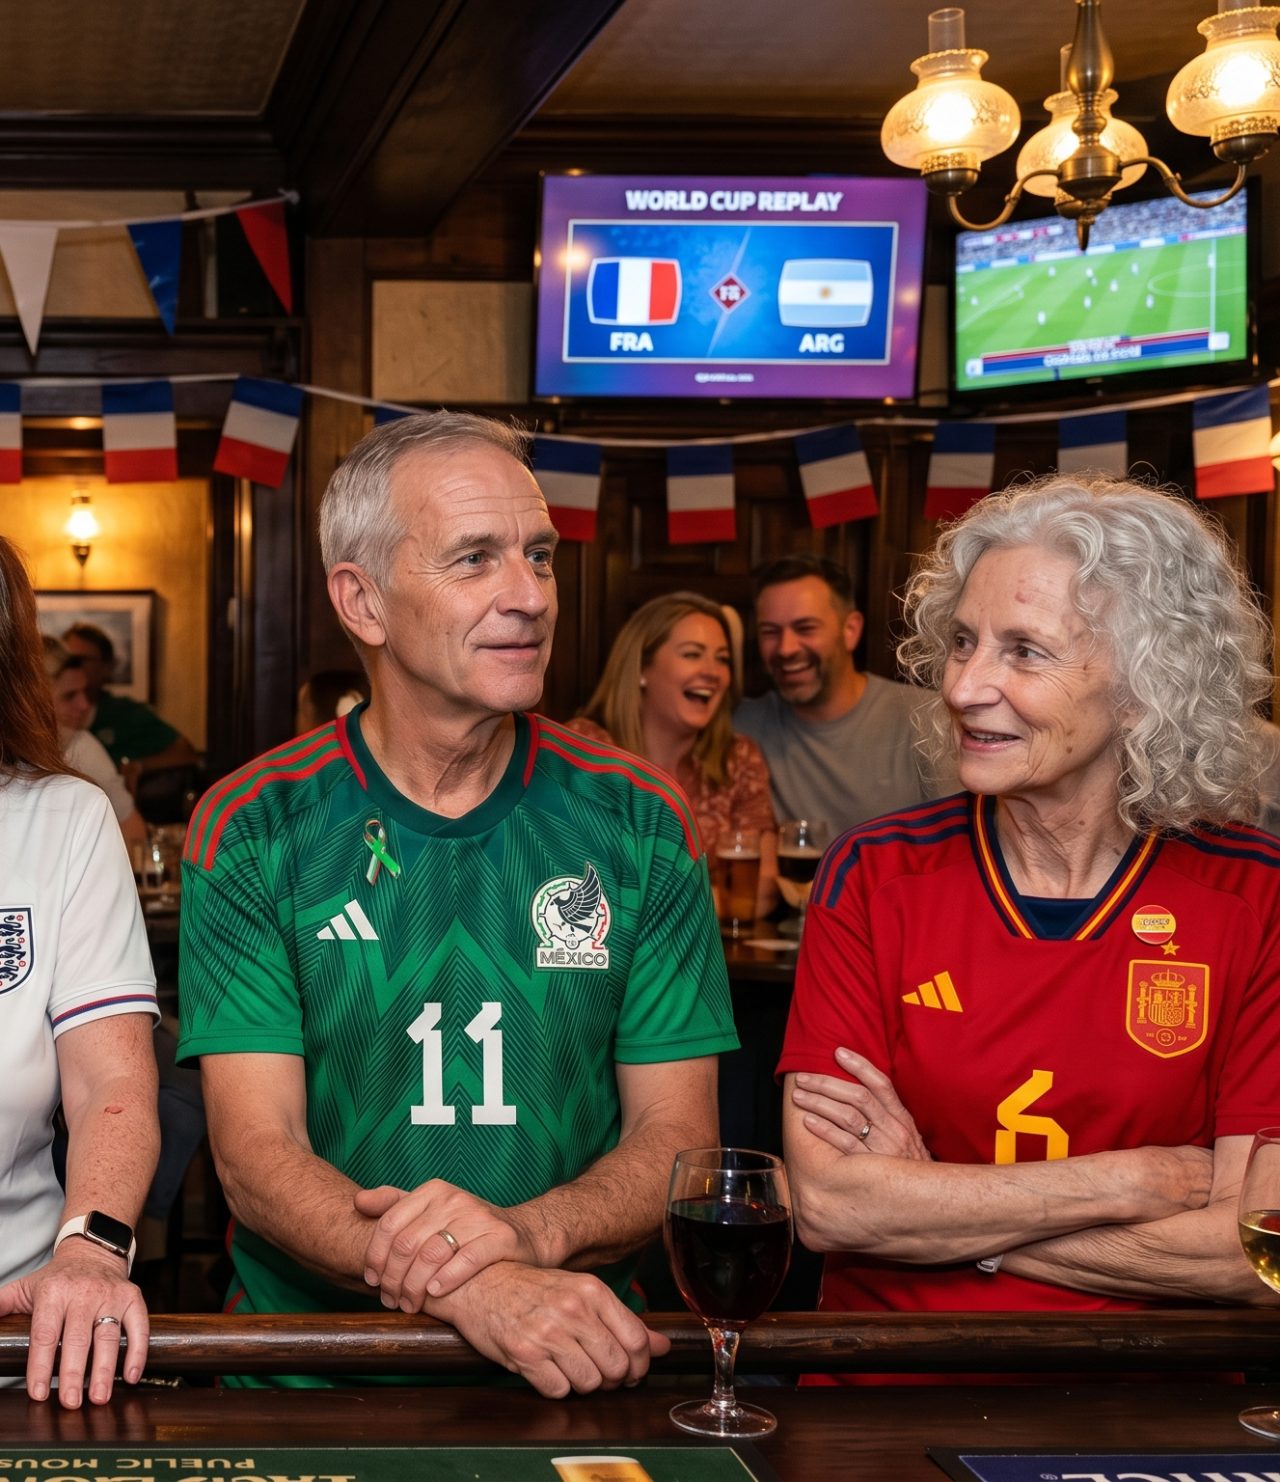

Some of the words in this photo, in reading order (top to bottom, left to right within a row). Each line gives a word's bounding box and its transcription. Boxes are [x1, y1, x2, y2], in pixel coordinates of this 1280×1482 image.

[625, 190, 708, 210] WORLD
[710, 191, 756, 211] CUP
[757, 191, 844, 211] REPLAY
[610, 331, 654, 351] FRA
[798, 333, 845, 353] ARG
[540, 948, 607, 966] MÉXICO
[406, 1002, 517, 1125] 11
[995, 1069, 1069, 1165] 6
